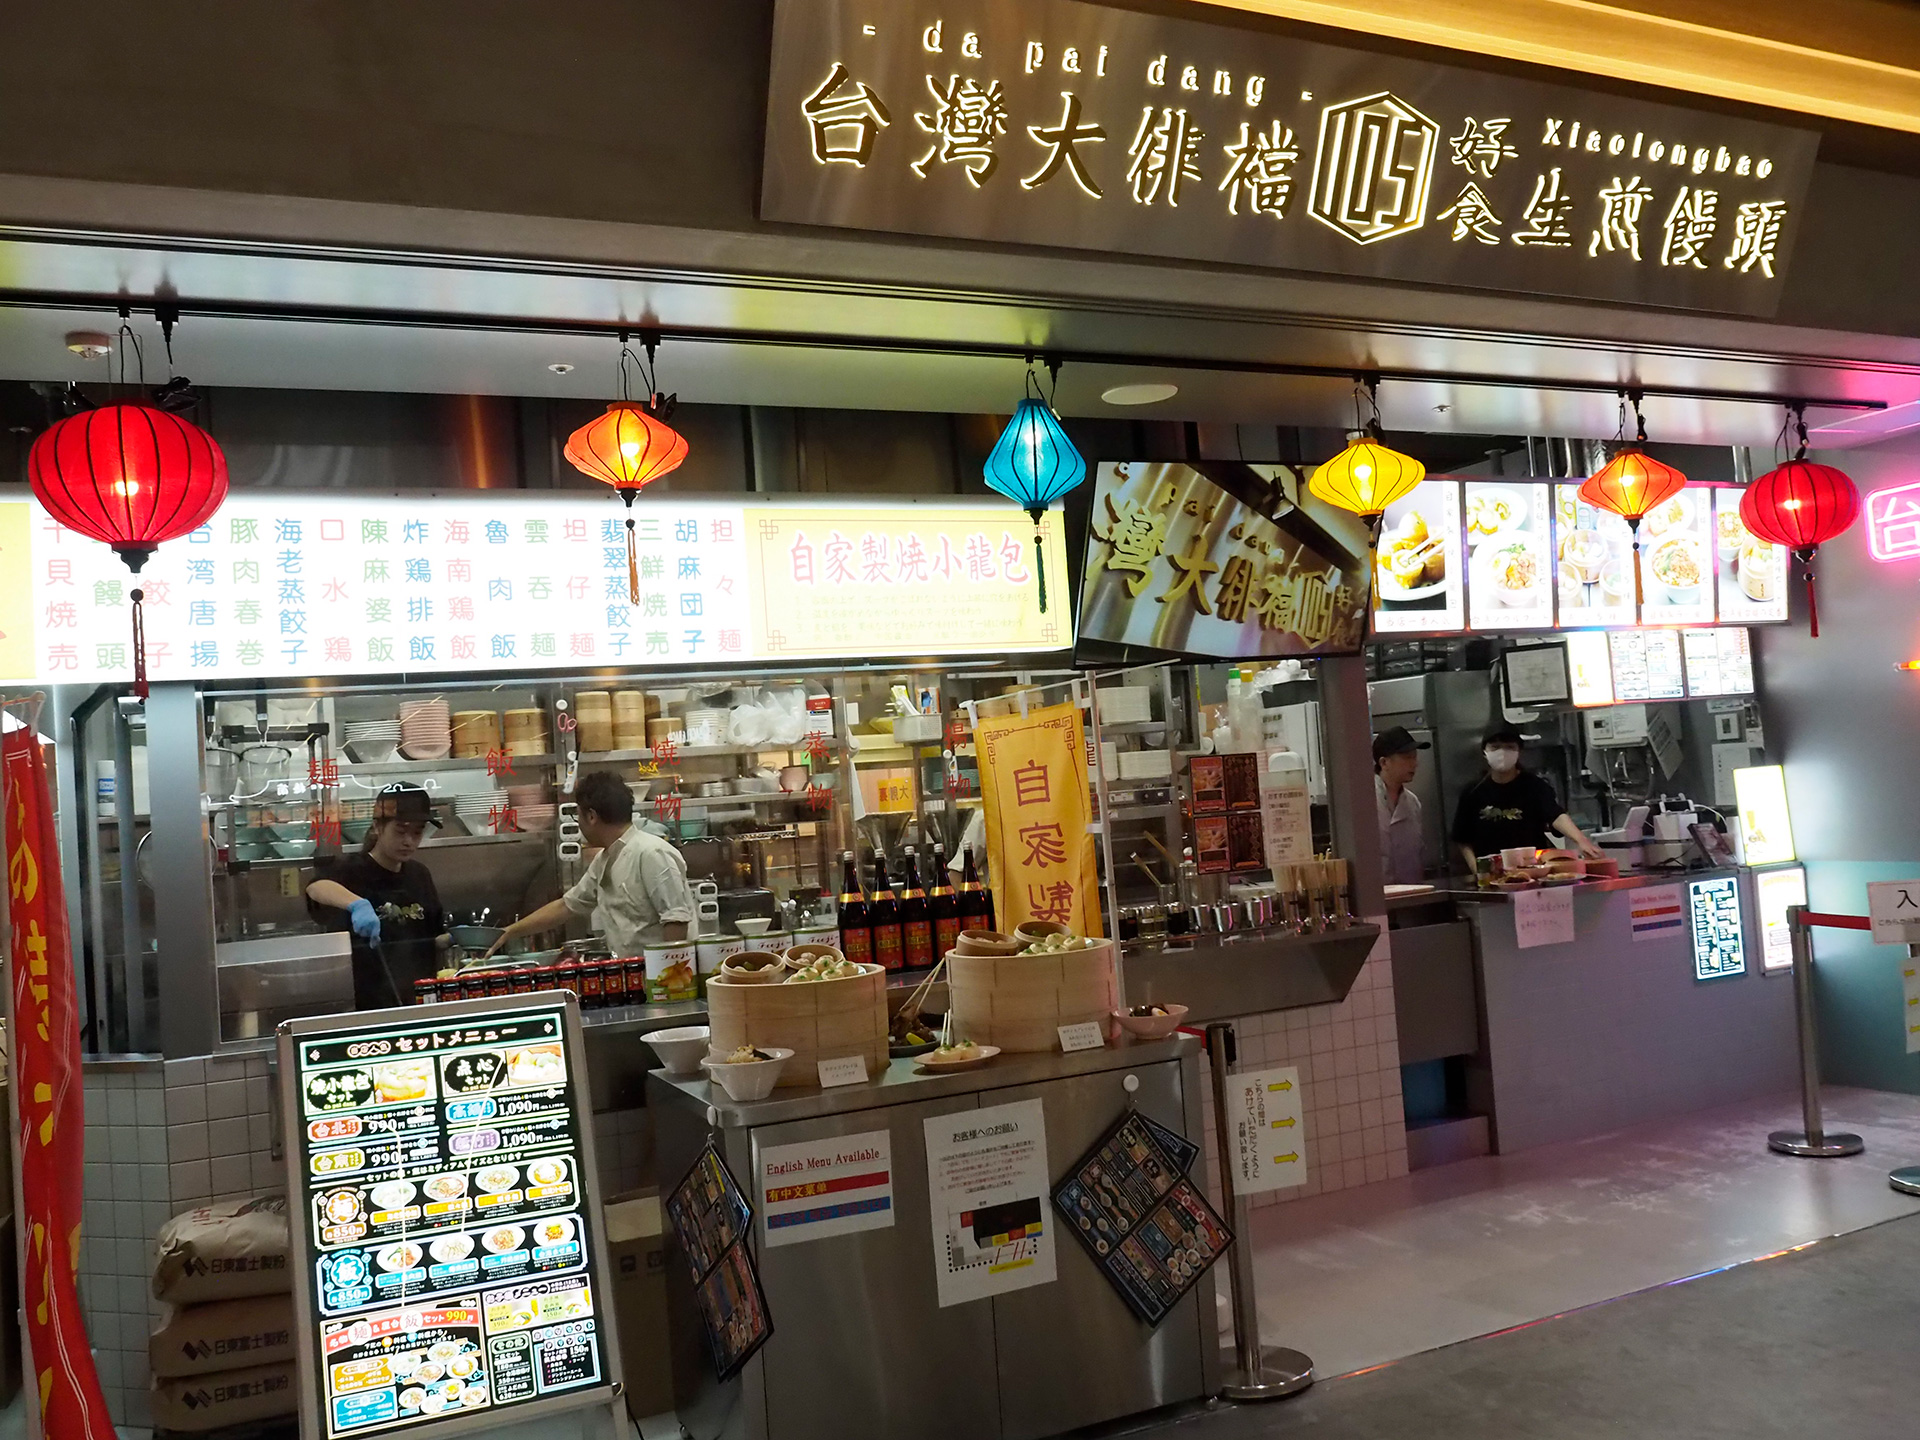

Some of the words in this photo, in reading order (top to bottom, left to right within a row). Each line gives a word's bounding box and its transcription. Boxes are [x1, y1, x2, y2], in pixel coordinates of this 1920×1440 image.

[922, 19, 983, 60] da
[1025, 38, 1109, 77] pai
[1145, 53, 1266, 108] dang
[1540, 117, 1775, 180] Xiaolongbao
[187, 519, 220, 668] 台湾唐揚
[230, 518, 265, 666] 豚肉春巻
[274, 517, 309, 665] 海老蒸餃子
[320, 518, 353, 663] 口水鶏
[361, 518, 395, 663] 陳麻婆飯
[403, 518, 437, 661] 炸鶏排飯
[443, 518, 478, 661] 海南鶏飯
[484, 518, 518, 659] 魯肉飯
[523, 518, 557, 658] 雲呑麺
[600, 518, 632, 657] 翡翠蒸餃子
[639, 518, 670, 656] 三鮮焼売
[675, 519, 706, 654] 胡麻団子
[710, 519, 742, 653] 担々麺
[790, 532, 1030, 585] 自家製焼小龍包
[485, 748, 518, 834] 飯物
[650, 738, 682, 822] 焼物
[804, 730, 833, 812] 蒸物
[1896, 889, 1919, 909] 入
[396, 1026, 518, 1053] セットメニュー
[766, 1159, 803, 1176] English
[806, 1155, 832, 1170] Menu
[835, 1148, 880, 1166] Available
